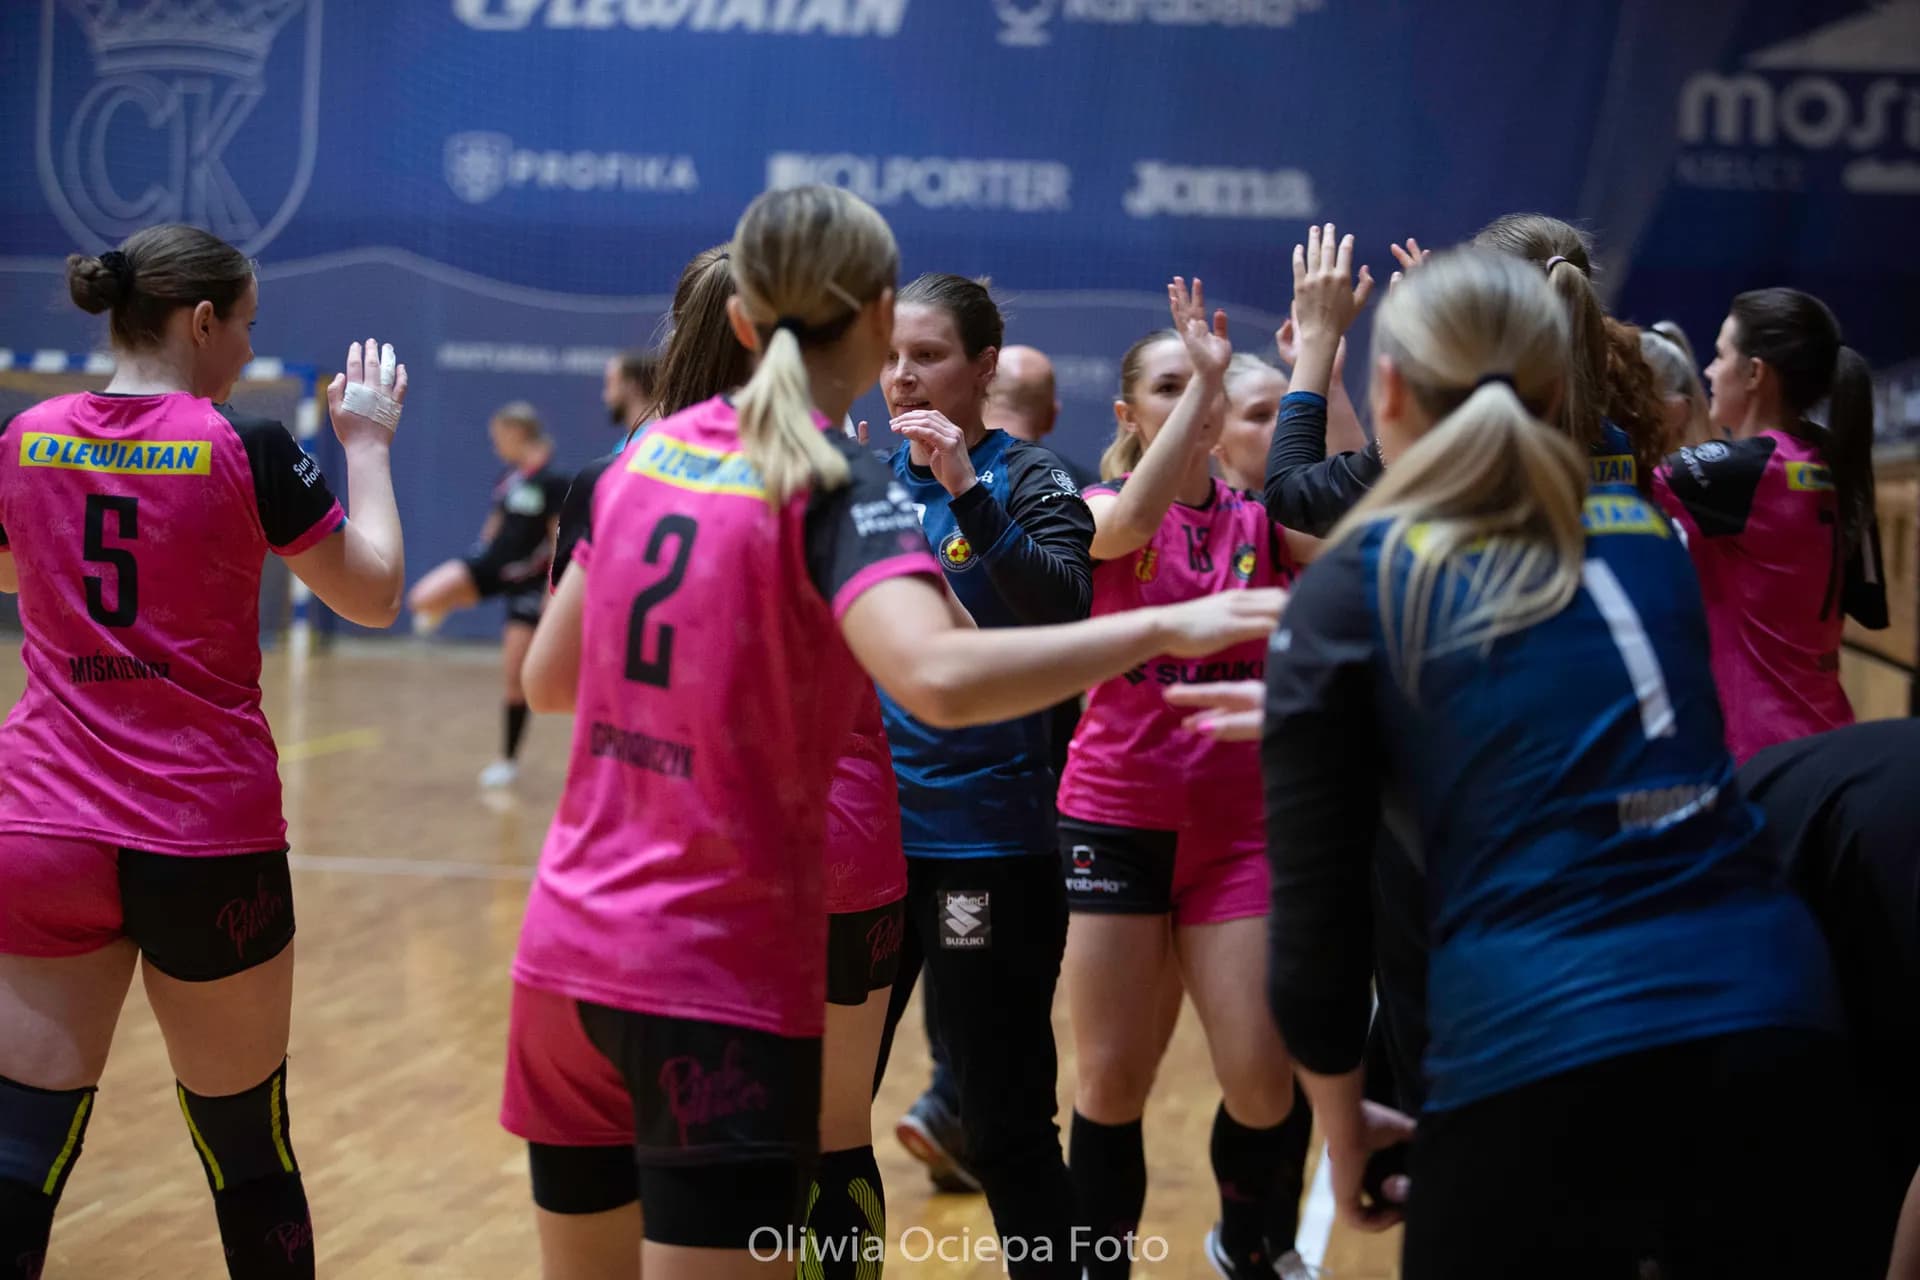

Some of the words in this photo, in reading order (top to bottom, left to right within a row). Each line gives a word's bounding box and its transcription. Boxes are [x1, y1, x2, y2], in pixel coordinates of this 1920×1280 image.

[60, 440, 199, 470] LEWIATAN
[81, 493, 140, 628] 5
[624, 514, 698, 689] 2
[945, 936, 985, 946] SUZUKI
